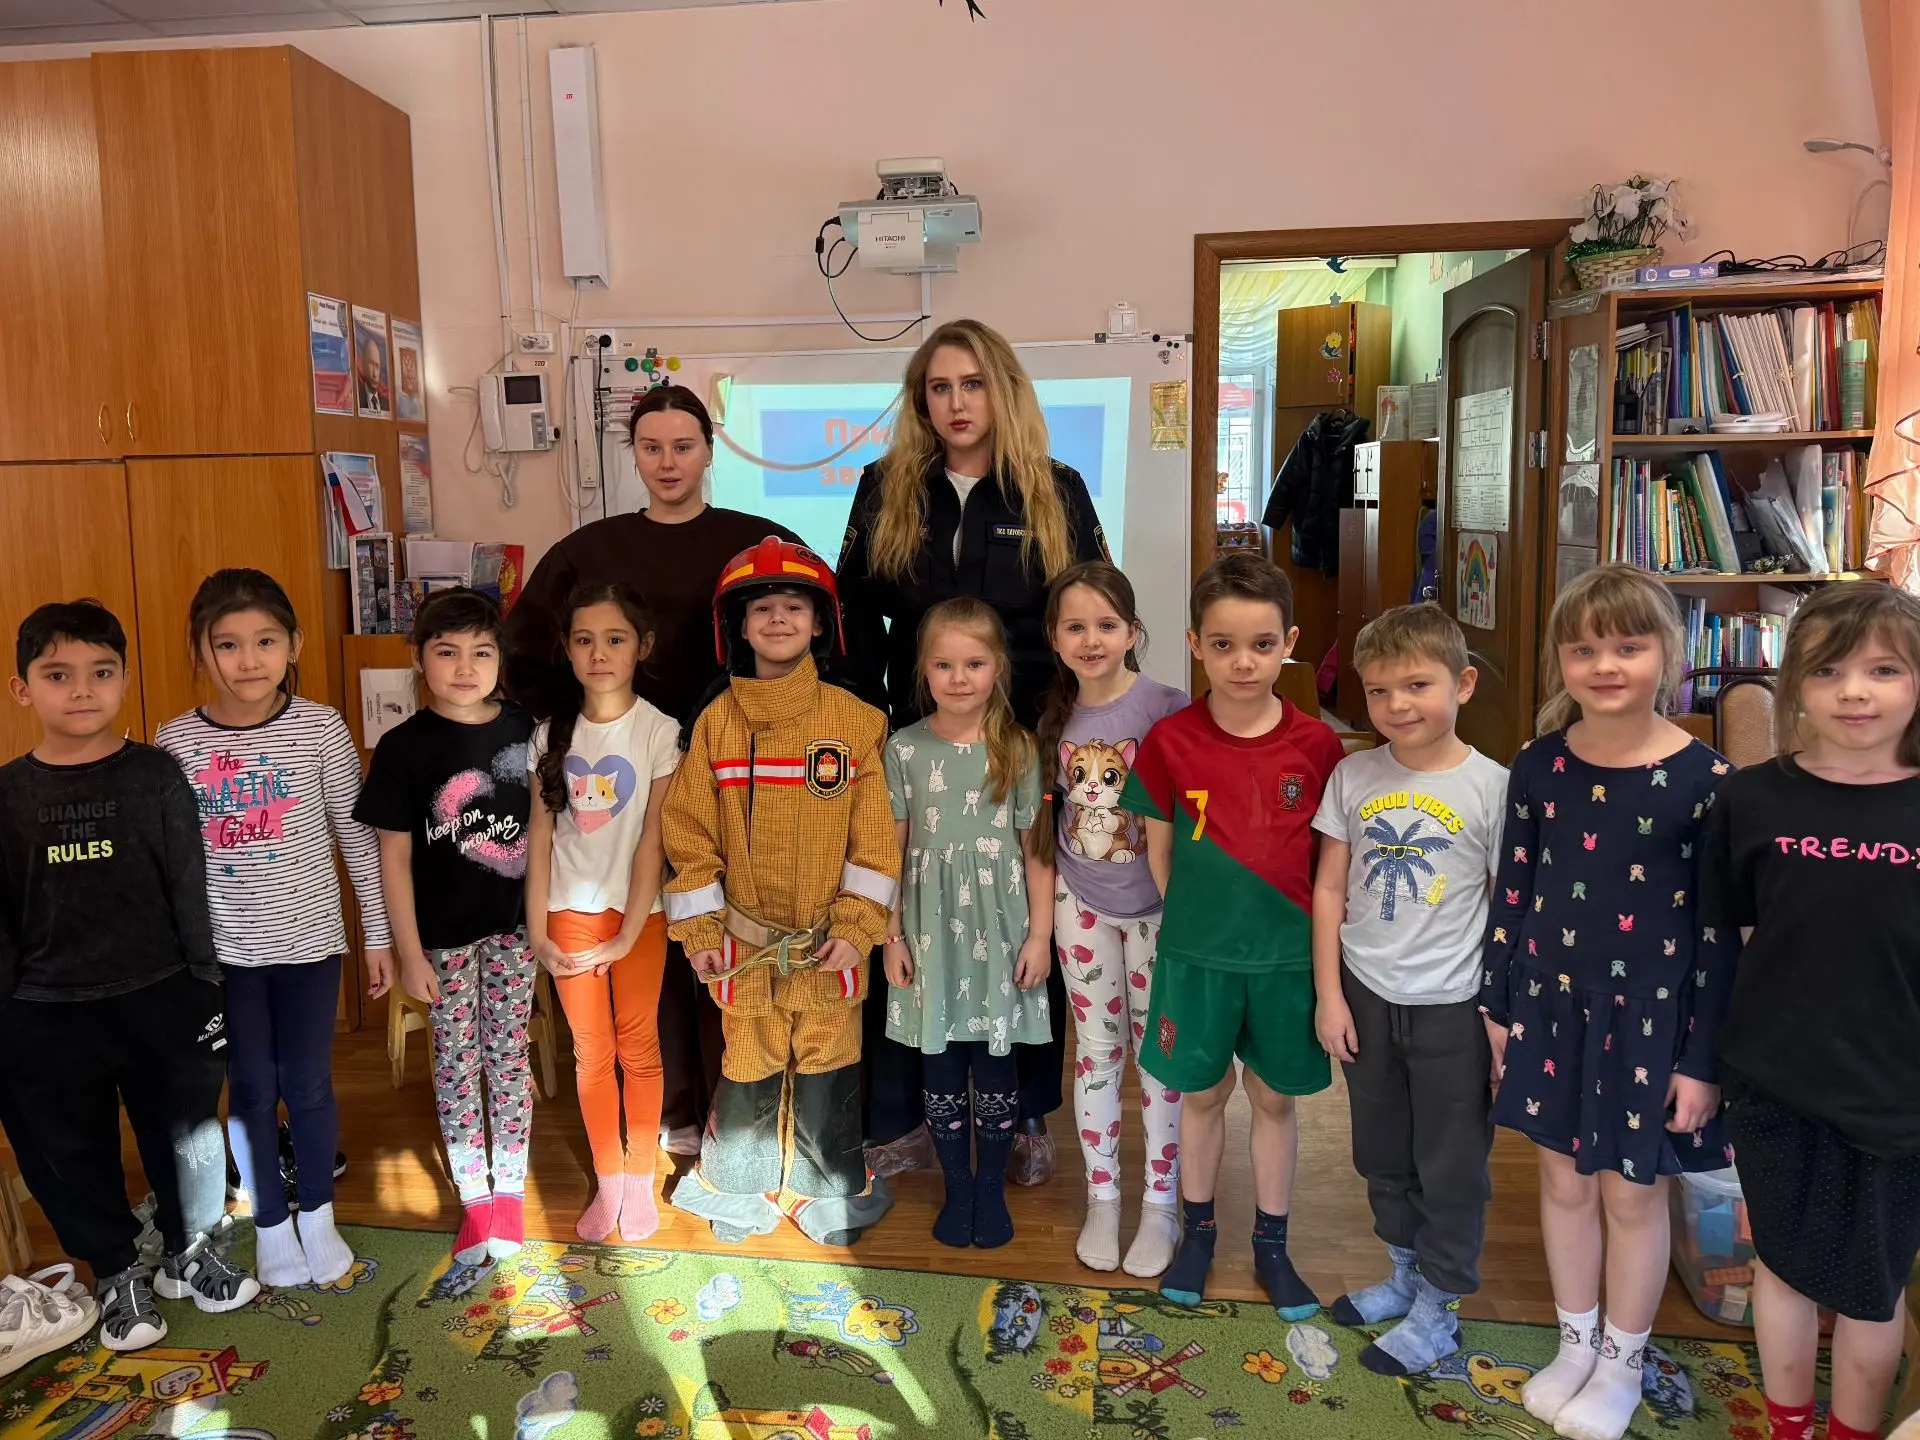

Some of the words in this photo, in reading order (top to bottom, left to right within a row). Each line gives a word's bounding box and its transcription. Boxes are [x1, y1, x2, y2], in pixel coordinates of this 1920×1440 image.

[217, 750, 239, 771] the
[38, 801, 117, 823] CHANGE
[220, 810, 274, 849] Girl
[426, 817, 460, 845] keep
[463, 808, 484, 826] on
[1186, 790, 1208, 841] 7
[1360, 791, 1409, 820] GOOD
[1413, 792, 1465, 834] VIBES
[58, 822, 96, 840] THE
[461, 813, 520, 854] moving
[47, 840, 113, 864] RULES
